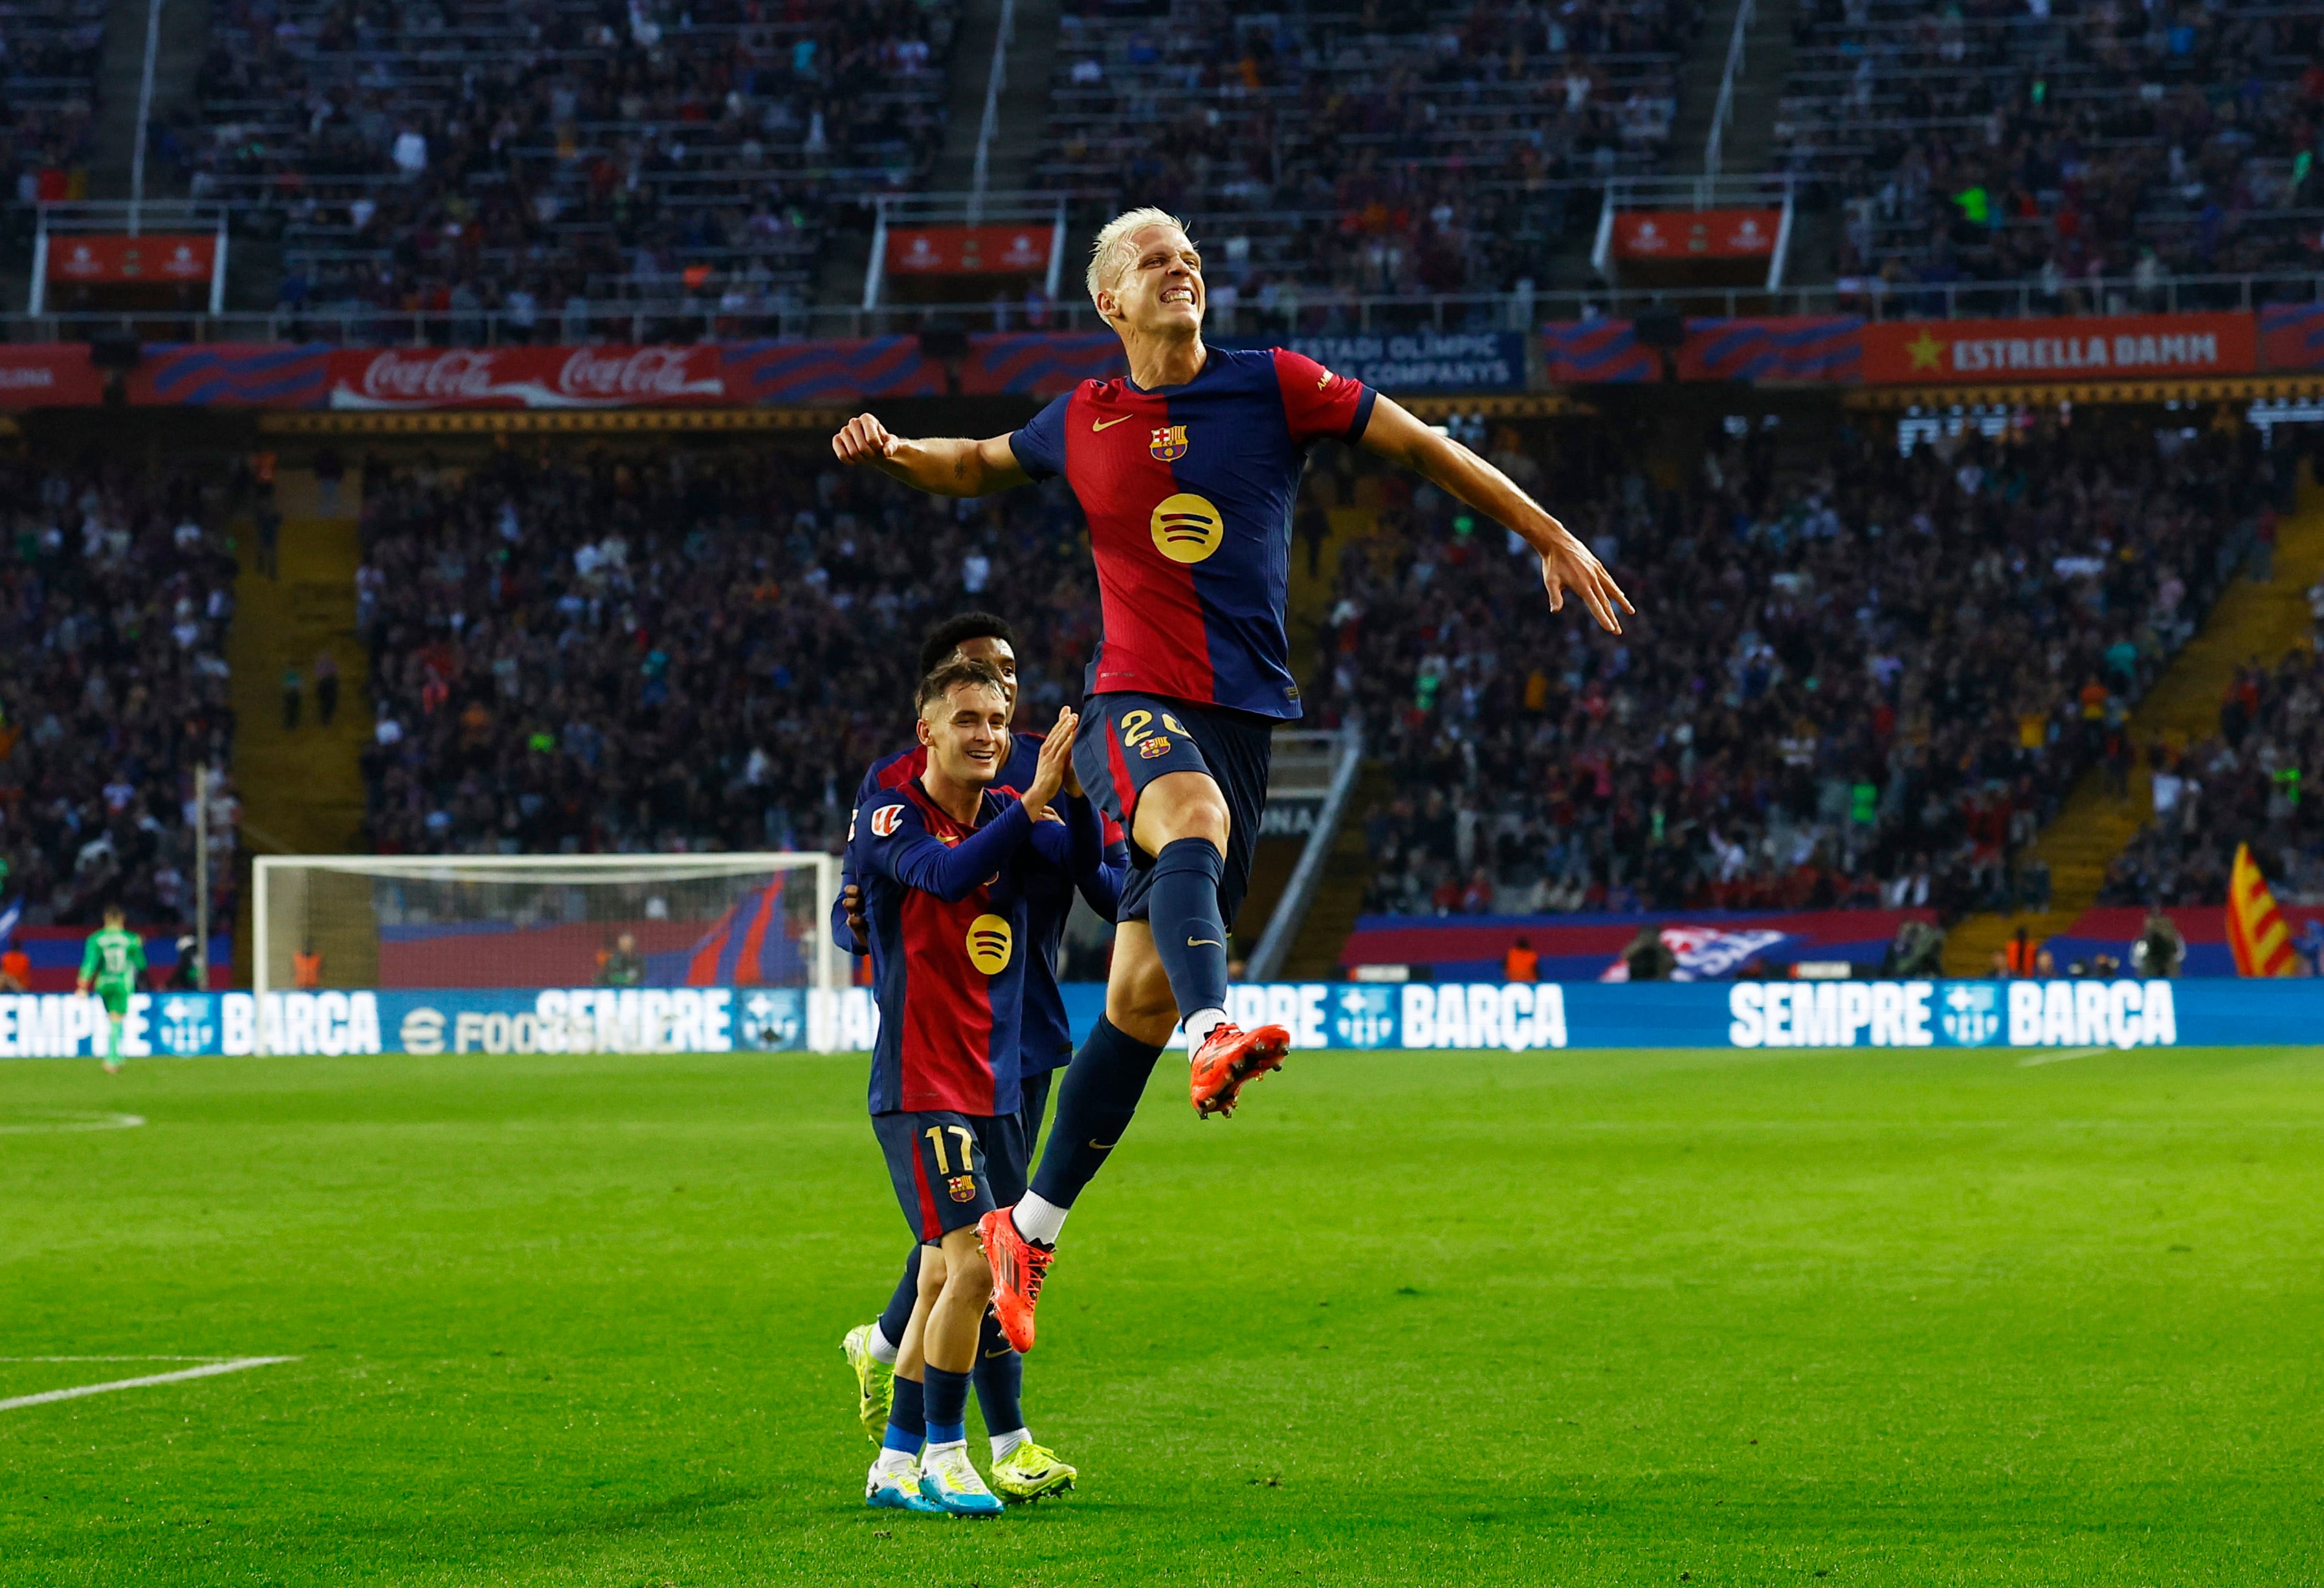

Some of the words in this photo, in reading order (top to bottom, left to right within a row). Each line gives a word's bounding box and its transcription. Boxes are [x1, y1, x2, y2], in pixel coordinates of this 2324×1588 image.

[1953, 338, 2108, 371] ESTRELLA
[2114, 333, 2217, 367] DAMM
[1402, 983, 1567, 1052] BARÇA
[1729, 981, 1934, 1048] SEMPRE
[2009, 980, 2177, 1050] BARÇA
[925, 1125, 973, 1175] 17
